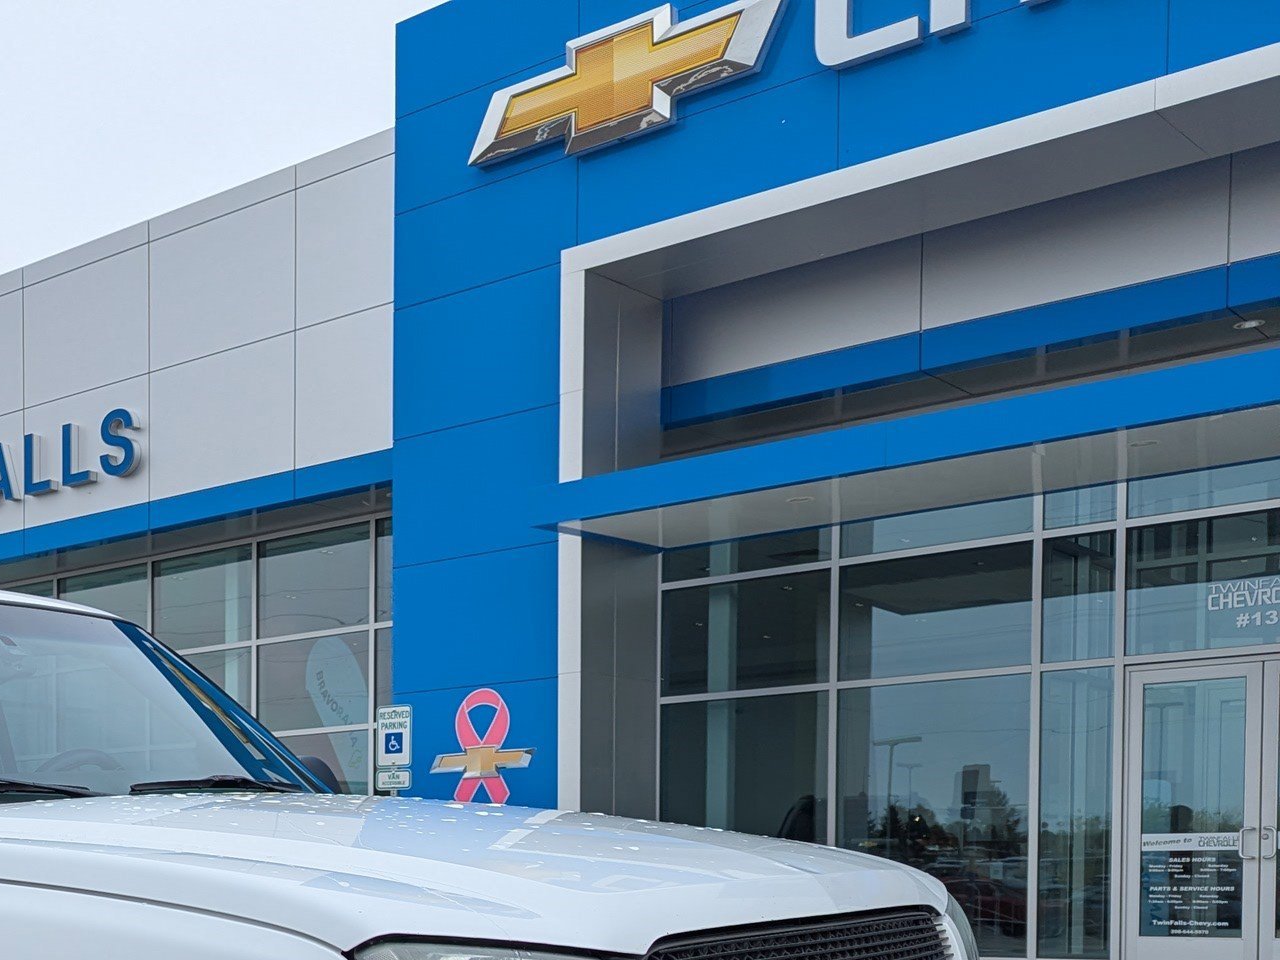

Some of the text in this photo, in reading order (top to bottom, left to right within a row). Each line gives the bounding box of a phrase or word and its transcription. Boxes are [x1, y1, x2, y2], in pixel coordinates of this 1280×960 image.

[380, 710, 410, 720] RESERVED
[381, 721, 407, 730] PARKING
[1143, 839, 1181, 847] Welcome
[1152, 919, 1229, 927] TwinFalls-Chevy.com
